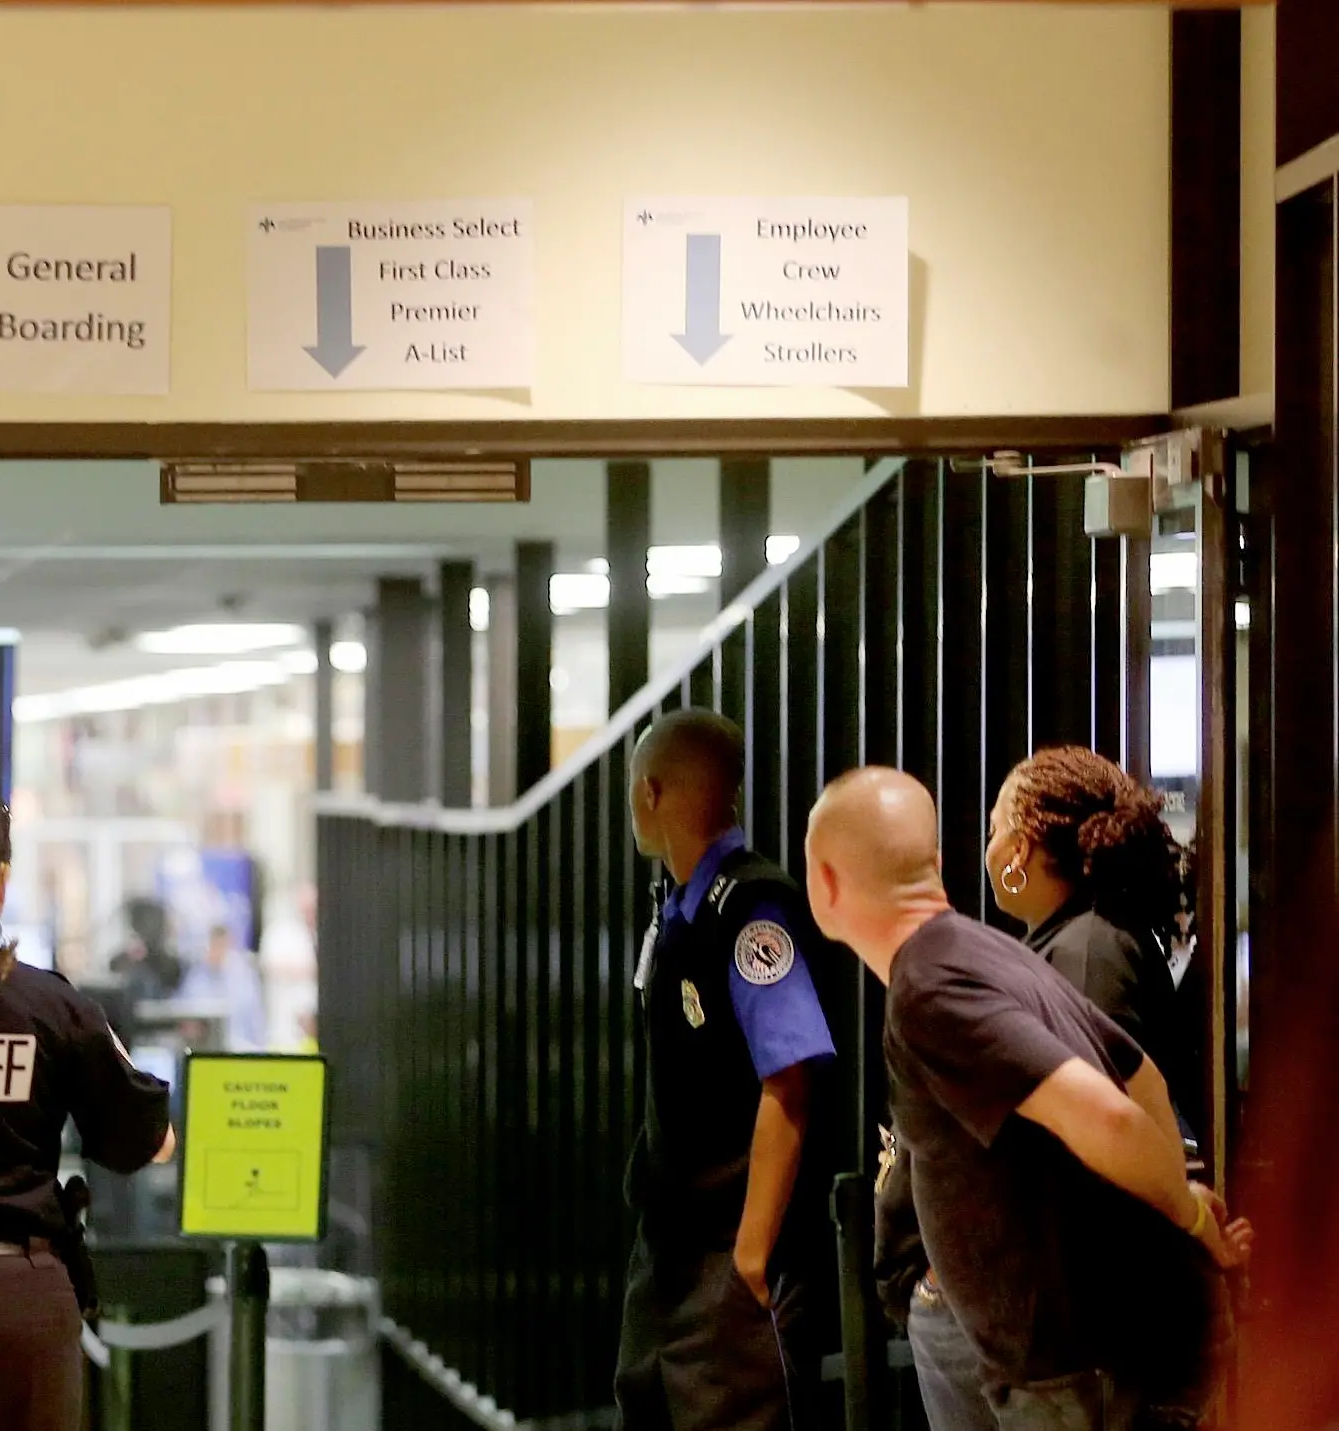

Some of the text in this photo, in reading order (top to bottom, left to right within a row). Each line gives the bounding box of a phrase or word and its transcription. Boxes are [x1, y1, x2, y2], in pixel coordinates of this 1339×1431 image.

[347, 218, 446, 240] Business
[452, 216, 522, 238] Select
[756, 217, 869, 243] Employee
[6, 251, 137, 282] General
[379, 259, 492, 281] First Class
[782, 259, 841, 281] Crew
[390, 301, 481, 322] Premier
[740, 300, 882, 322] Wheelchairs
[404, 343, 468, 363] A-List
[763, 341, 858, 364] Strollers
[222, 1081, 289, 1094] CAUTION
[230, 1099, 280, 1111] FLOOR
